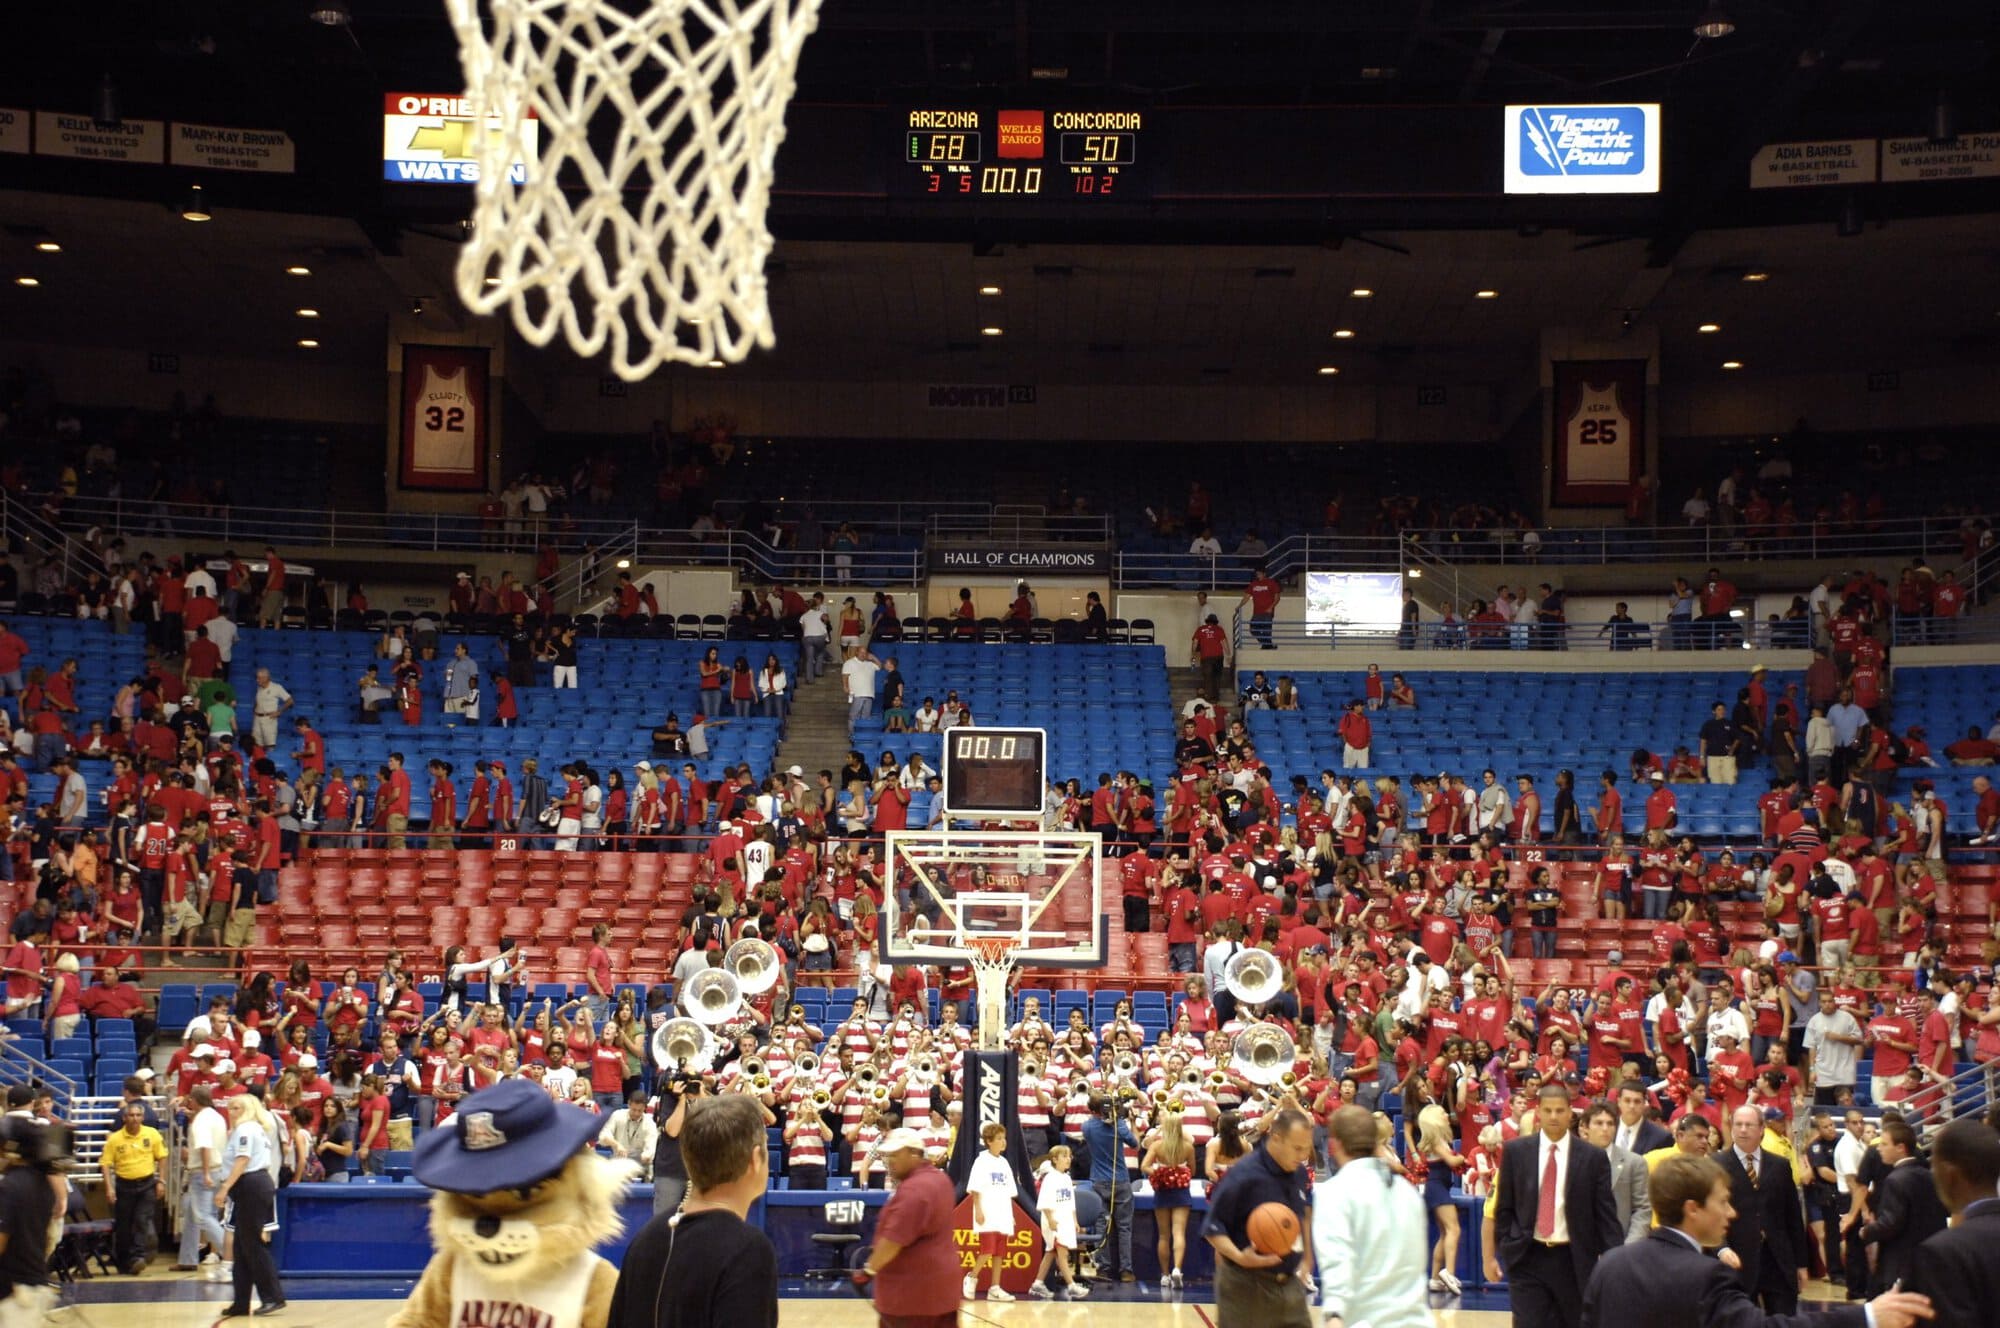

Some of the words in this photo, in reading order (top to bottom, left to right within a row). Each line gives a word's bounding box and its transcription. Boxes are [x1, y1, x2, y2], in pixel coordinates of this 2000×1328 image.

[909, 111, 978, 128] ARIZONA
[1053, 112, 1141, 130] CONCORDIA
[1549, 114, 1620, 132] Tucson
[242, 131, 285, 145] BROWN
[1000, 124, 1042, 134] WELLS
[61, 133, 139, 148] GYMNASTICS
[929, 134, 965, 160] 68
[1001, 135, 1042, 145] FARGO
[1083, 136, 1119, 161] 50
[1557, 131, 1634, 149] Electric
[194, 144, 270, 158] GYMNASTICS
[1563, 148, 1634, 166] Power
[1775, 147, 1802, 159] ADIA
[1806, 144, 1852, 157] BARNES
[398, 161, 525, 183] WATSN
[981, 168, 1042, 193] 00.0
[928, 174, 940, 192] 3
[959, 174, 972, 192] 5
[1075, 175, 1094, 193] 10
[1100, 175, 1113, 193] 2
[428, 392, 463, 403] ELLIOTT
[929, 386, 1005, 407] NORTH
[425, 406, 465, 432] 32
[1580, 419, 1617, 445] 25
[944, 553, 980, 564] HALL
[986, 553, 1004, 565] OF
[1009, 553, 1095, 566] CHAMPIONS
[957, 736, 1017, 759] 00.0
[146, 838, 166, 856] 21
[500, 839, 516, 850] 20
[748, 848, 763, 864] 43
[1526, 850, 1542, 862] 22
[1569, 988, 1586, 1000] 22
[825, 1200, 865, 1224] FSN
